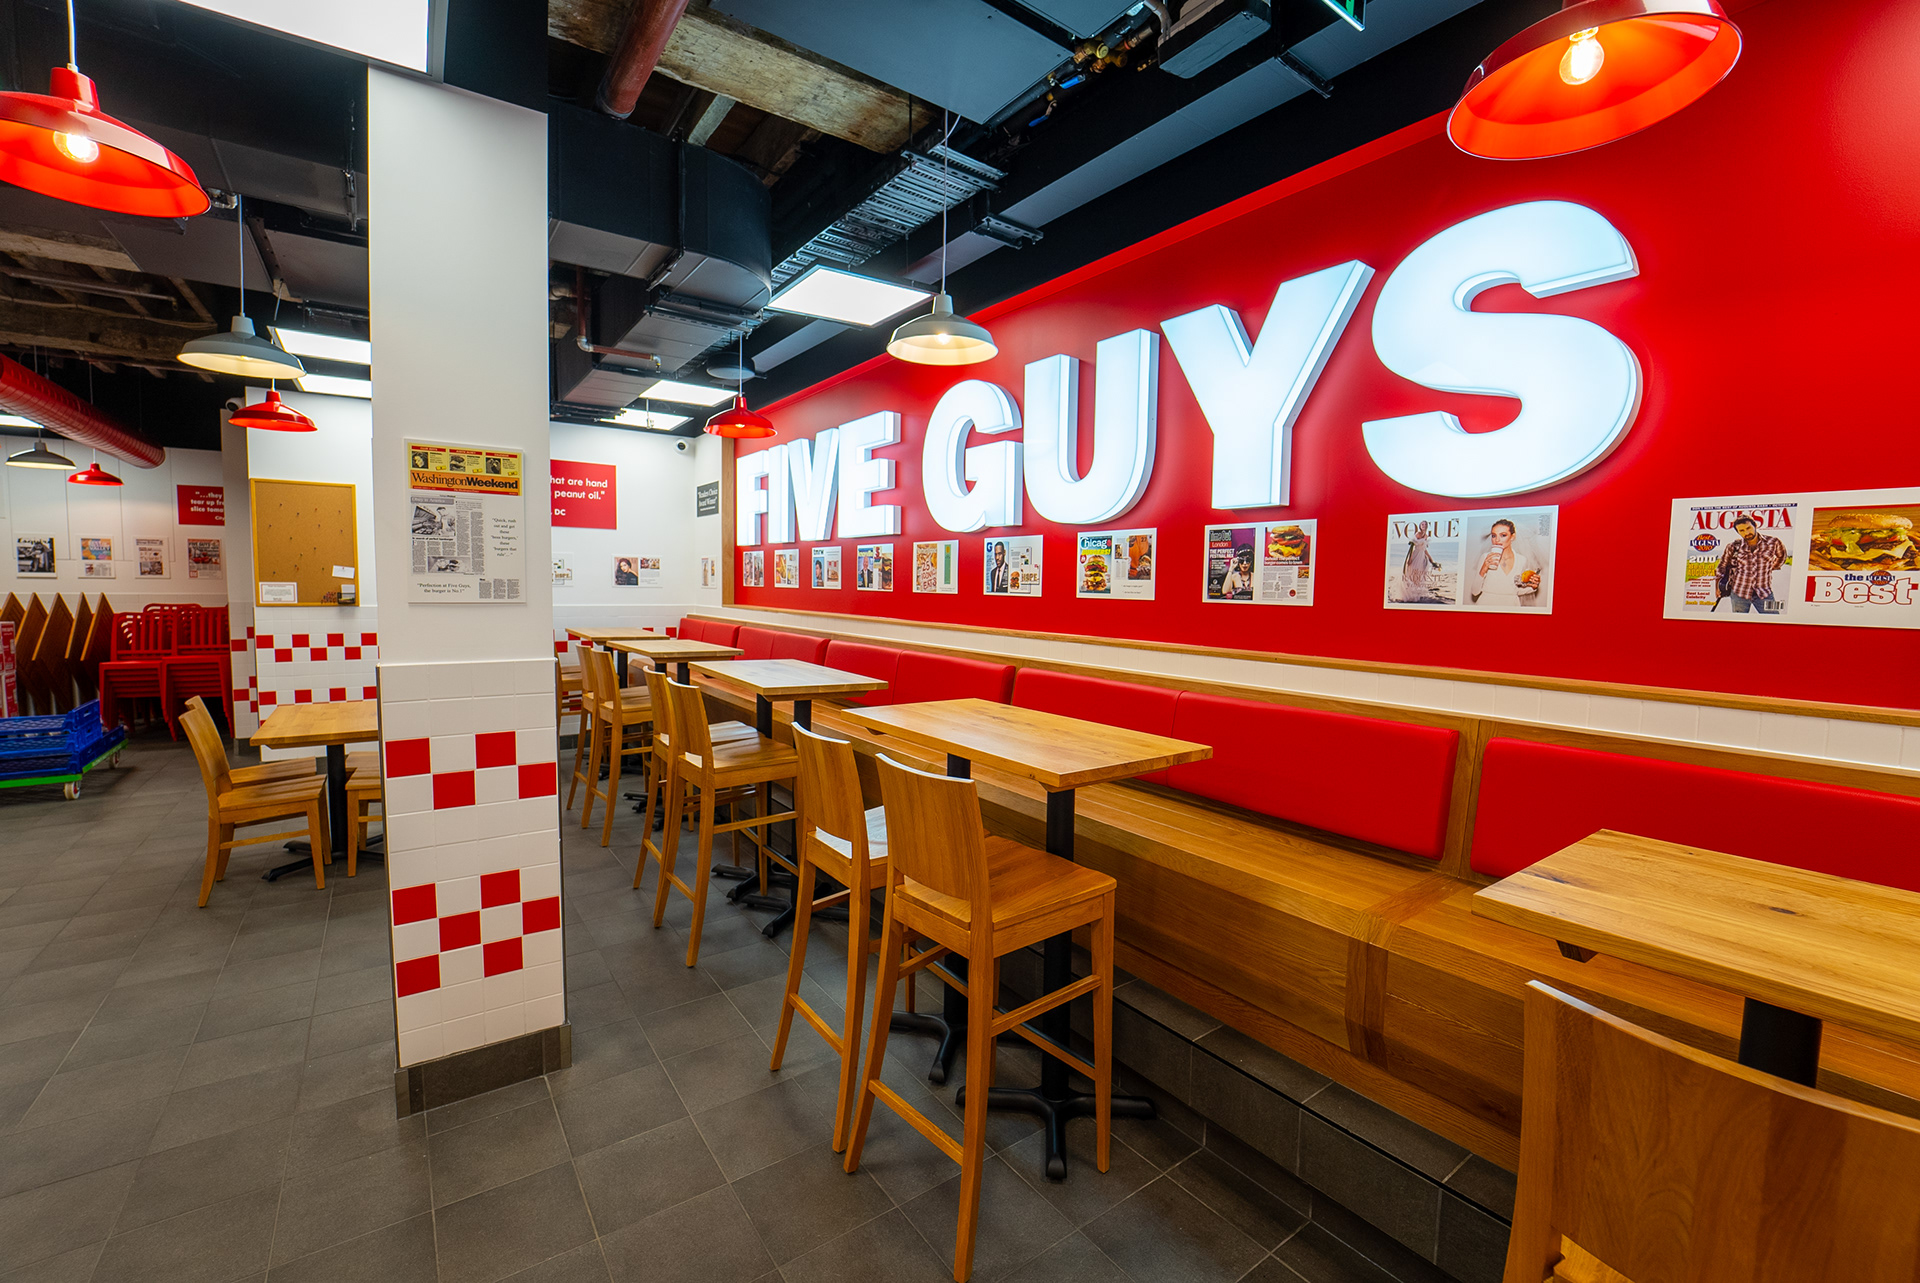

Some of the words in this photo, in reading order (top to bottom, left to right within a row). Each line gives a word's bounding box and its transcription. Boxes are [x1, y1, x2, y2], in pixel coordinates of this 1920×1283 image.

[737, 410, 901, 546] FIVE
[921, 200, 1643, 533] GUYS
[585, 478, 608, 488] hand
[554, 490, 586, 499] peanut
[1080, 536, 1112, 549] Chicag
[1689, 555, 1716, 563] 2010
[1808, 576, 1916, 605] Best
